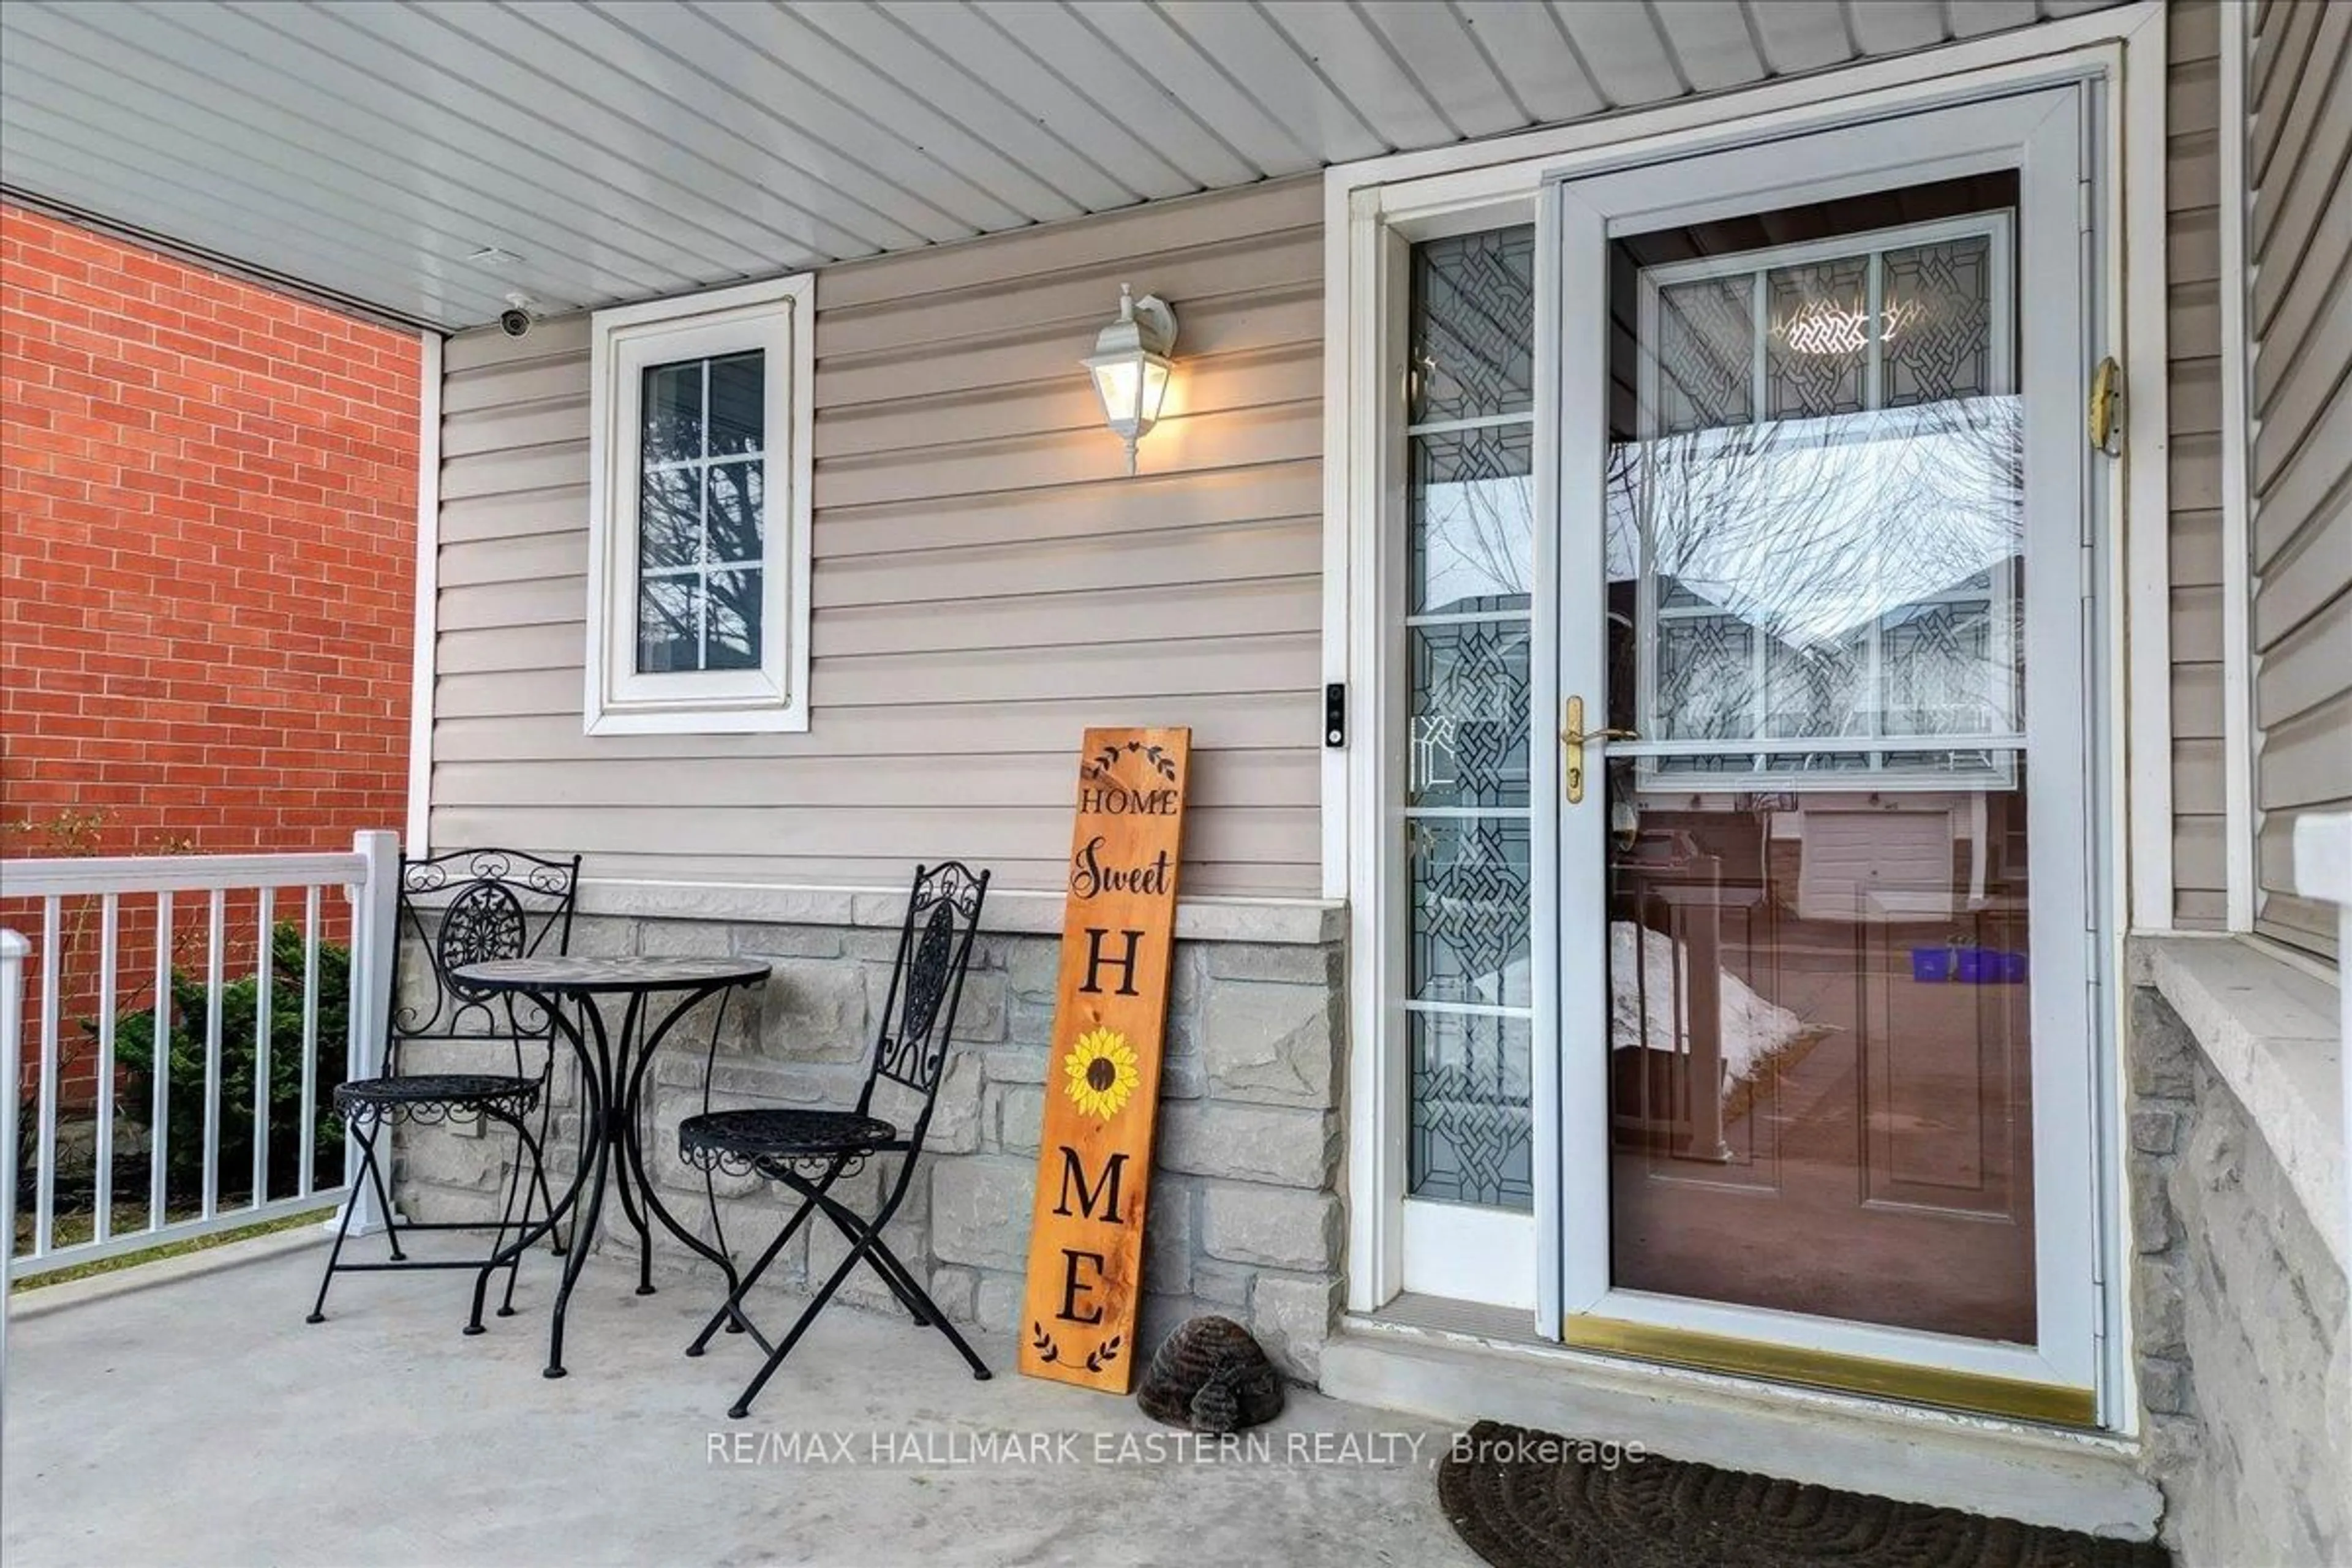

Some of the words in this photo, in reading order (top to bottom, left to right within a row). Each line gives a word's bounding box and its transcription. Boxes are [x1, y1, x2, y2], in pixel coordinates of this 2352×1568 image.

[1080, 789, 1179, 815] HOME
[1070, 836, 1175, 900] Sweet
[1079, 928, 1145, 996] H
[1052, 1146, 1129, 1224] M
[1055, 1248, 1104, 1325] E
